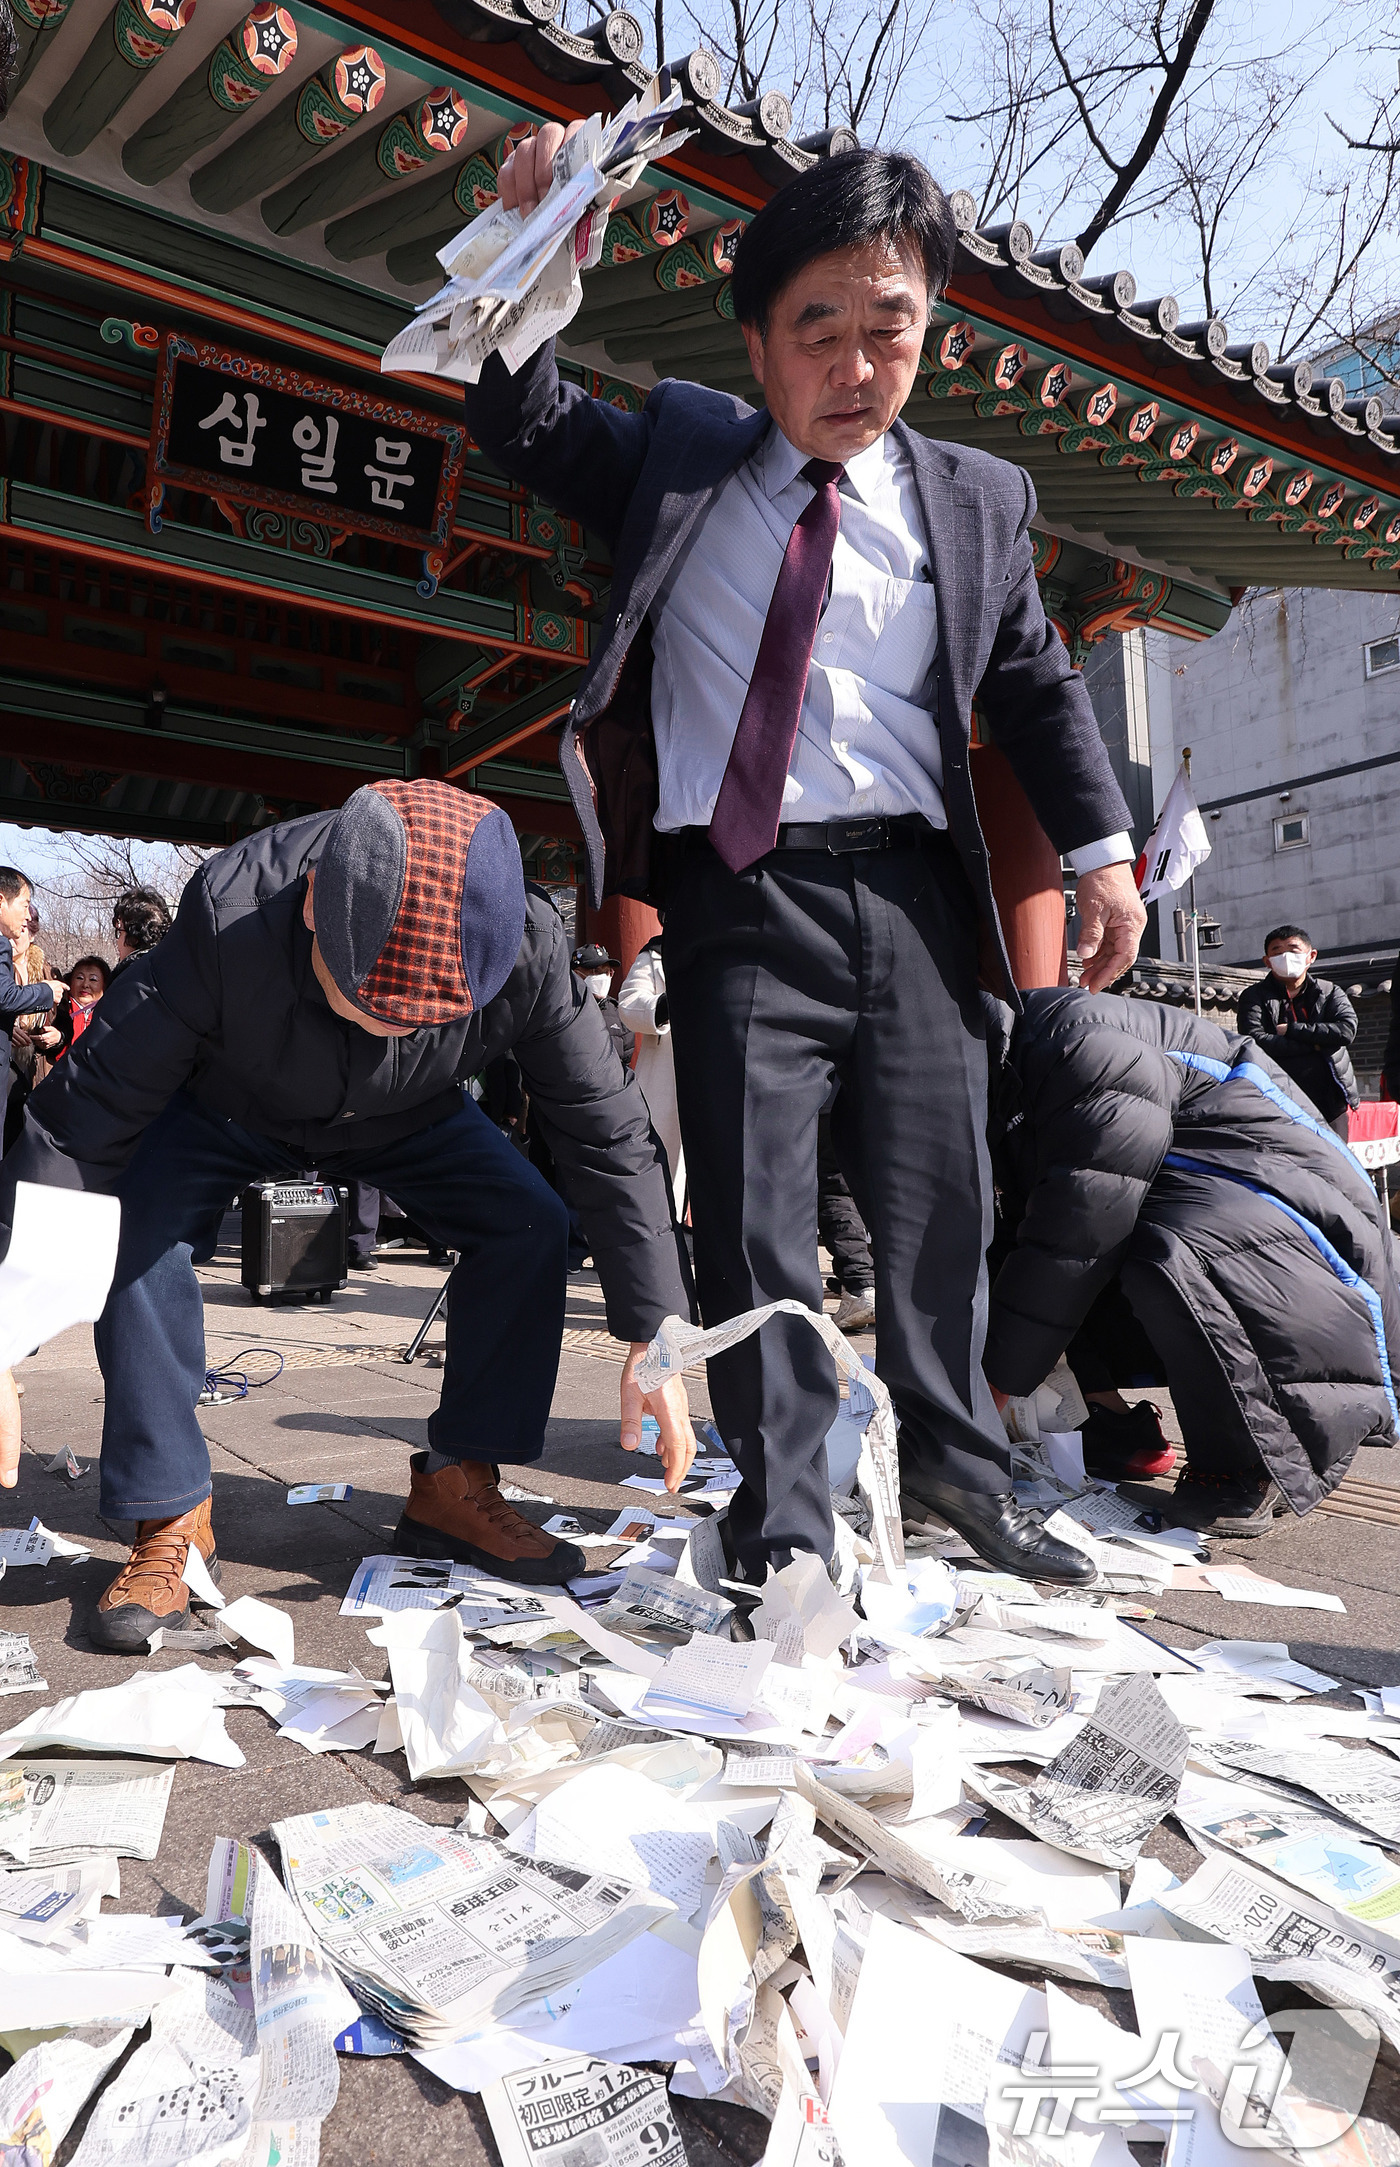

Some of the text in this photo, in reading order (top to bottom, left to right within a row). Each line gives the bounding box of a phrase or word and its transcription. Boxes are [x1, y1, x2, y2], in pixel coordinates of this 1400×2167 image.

[199, 392, 415, 511] 삼일문
[450, 1877, 519, 1918] 卓球王国
[378, 1916, 435, 1942] 軽自動車が
[487, 1904, 534, 1934] 全日本
